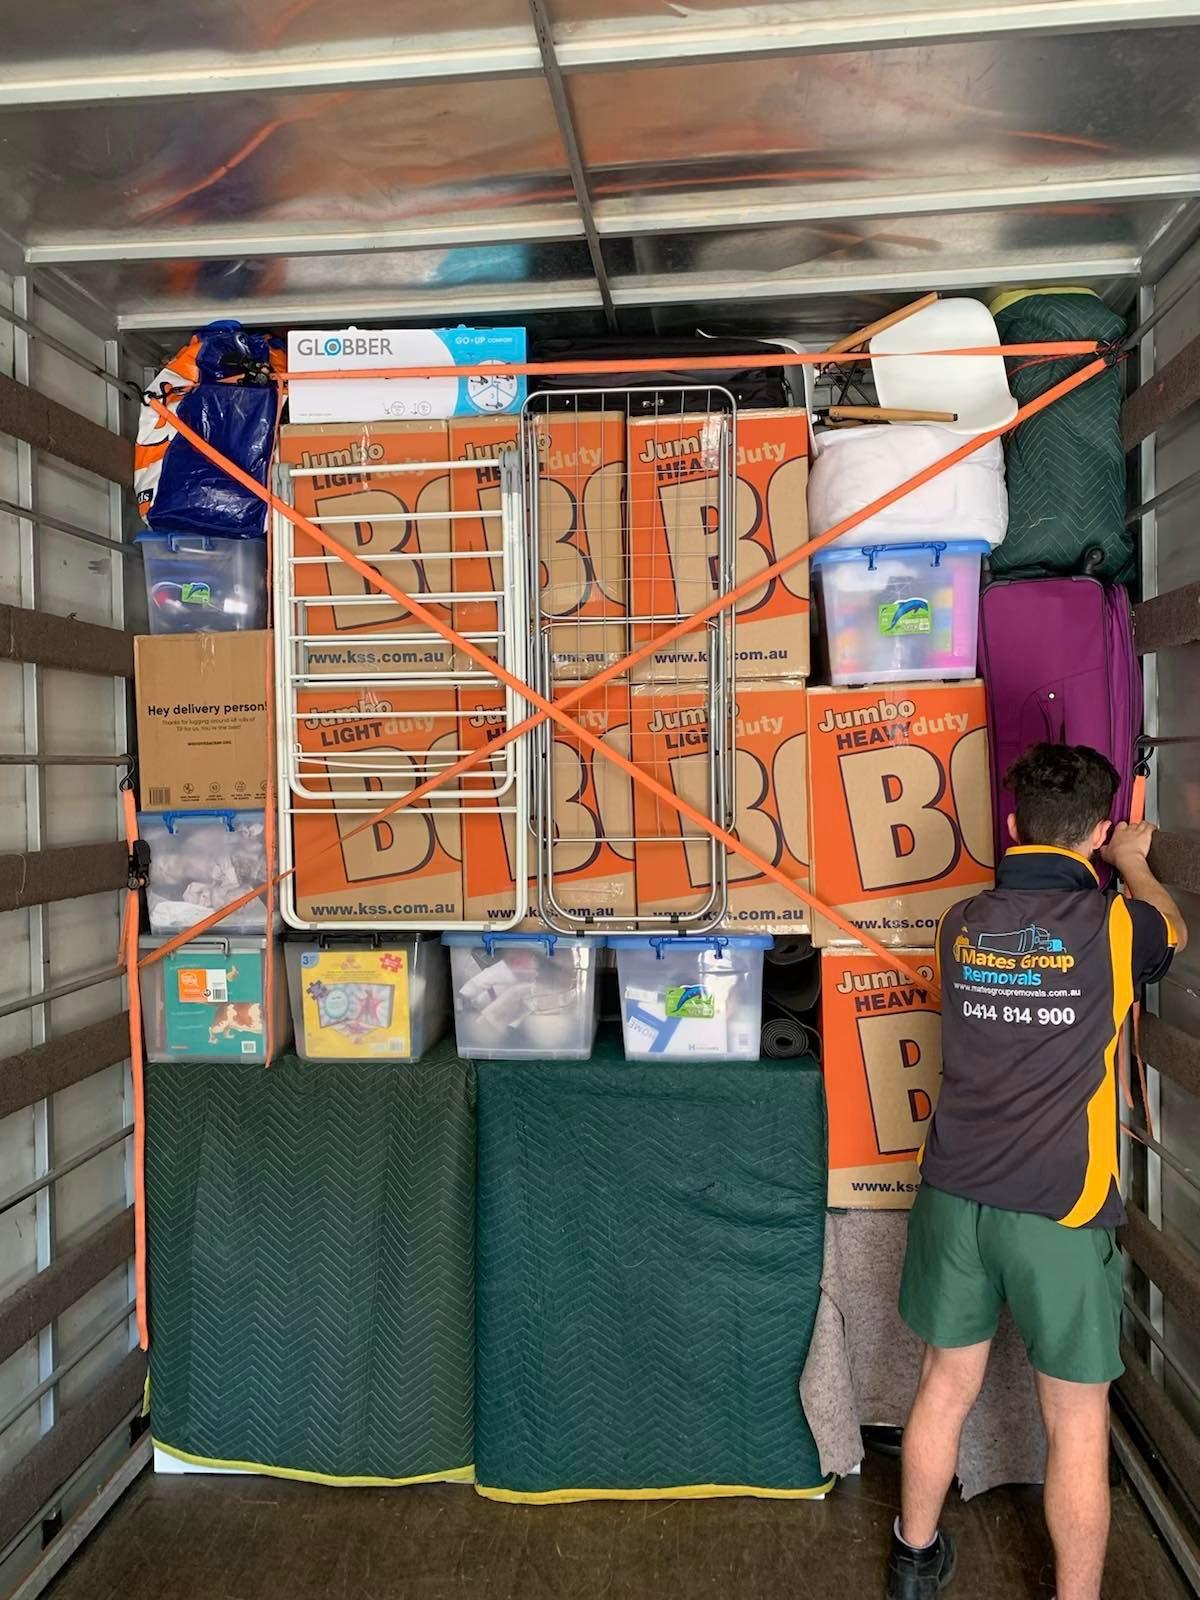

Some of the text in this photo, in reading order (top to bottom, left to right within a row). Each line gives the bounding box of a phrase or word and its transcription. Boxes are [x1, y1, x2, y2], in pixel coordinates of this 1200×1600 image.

[297, 338, 393, 356] GLOBBER
[295, 441, 385, 471] Jumbo
[458, 432, 553, 461] Jumo
[639, 428, 733, 463] Jum
[737, 441, 787, 466] duty
[550, 446, 602, 471] duty
[655, 650, 788, 664] www.k.om.au
[148, 701, 268, 717] Hey delivery person!
[305, 699, 393, 730] Jumbo
[647, 703, 740, 732] Jumo
[818, 699, 917, 733] Jumbo
[320, 716, 435, 747] LIGHT duty
[665, 728, 709, 749] LIG
[836, 711, 969, 750] HEAVY duty
[311, 902, 455, 916] www.kss.com.au
[848, 917, 939, 929] ww.kss.co
[962, 948, 1075, 973] Mates Group
[963, 965, 1042, 986] Removals
[854, 988, 928, 1012] HEAVY
[953, 982, 1081, 998] www.matesgroupremovals.com.au
[963, 1001, 1076, 1026] 0414 814 900
